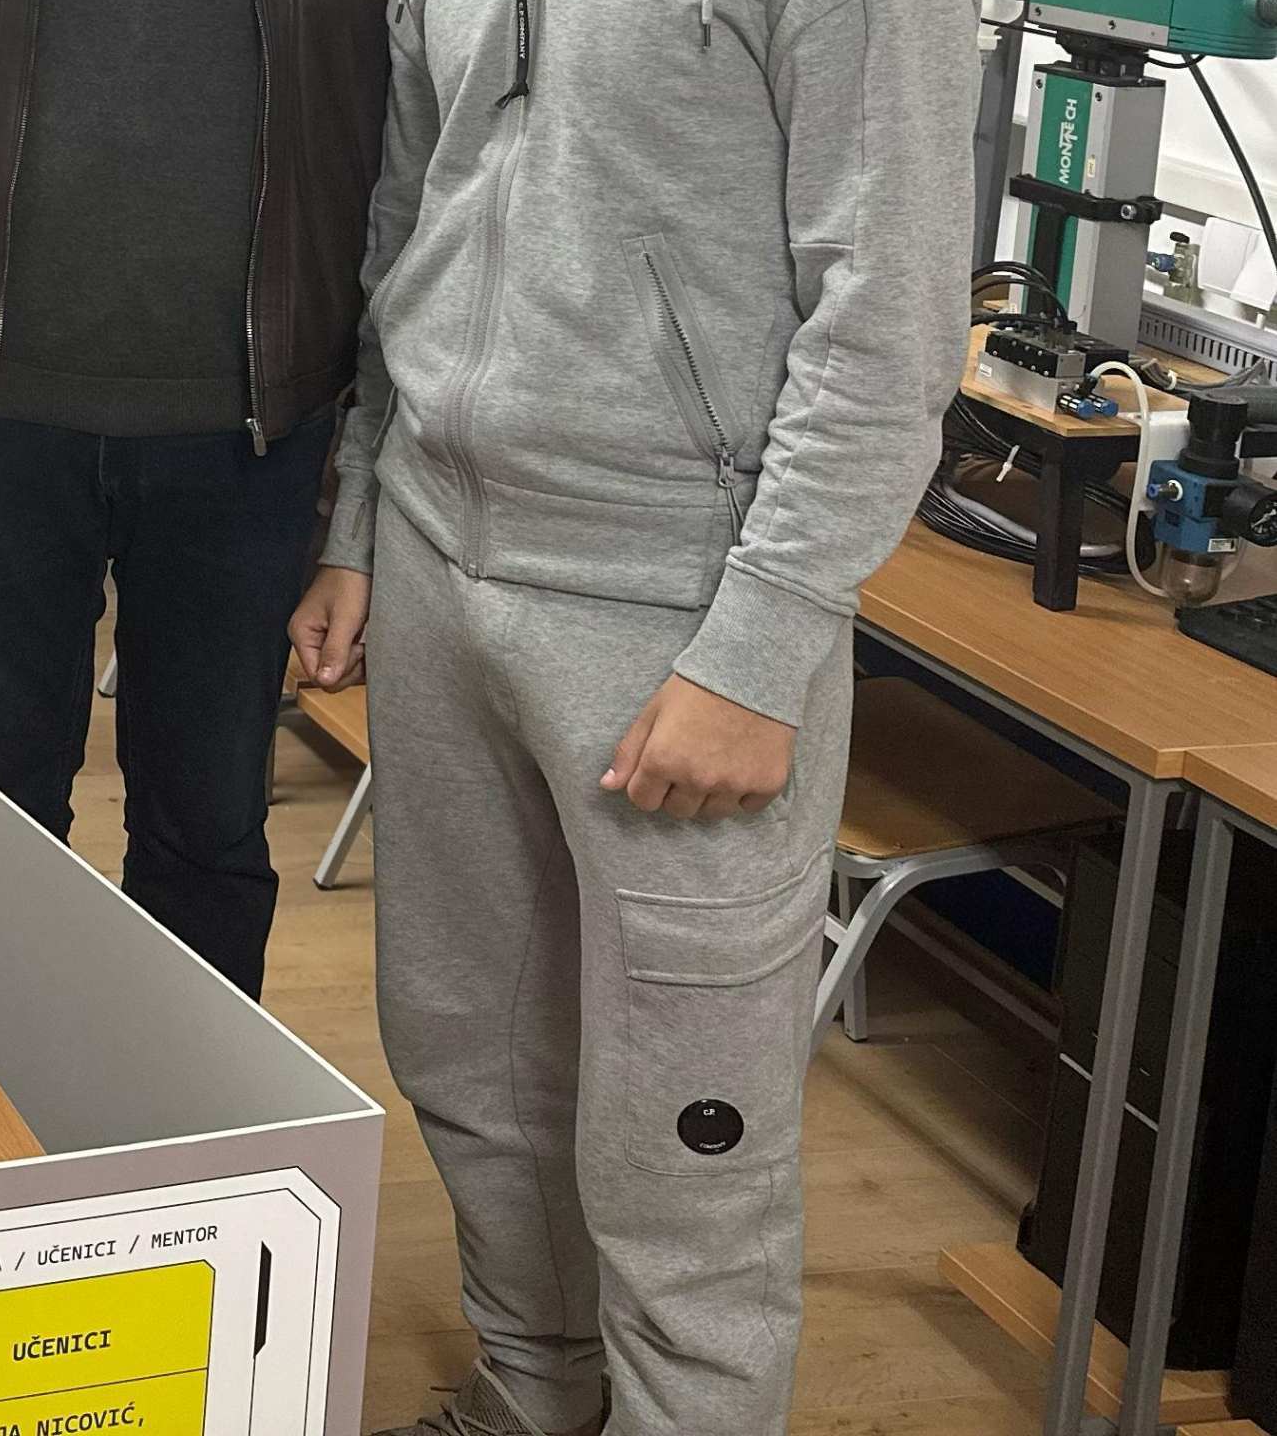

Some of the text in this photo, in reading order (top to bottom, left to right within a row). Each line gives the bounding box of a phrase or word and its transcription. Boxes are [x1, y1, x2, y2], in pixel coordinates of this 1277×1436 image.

[1058, 98, 1079, 184] MONTECH
[36, 1240, 117, 1266] UČENICI
[150, 1225, 218, 1249] MENTOR
[12, 1329, 112, 1362] UČENICI
[36, 1401, 146, 1436] NICOVIĆ,
